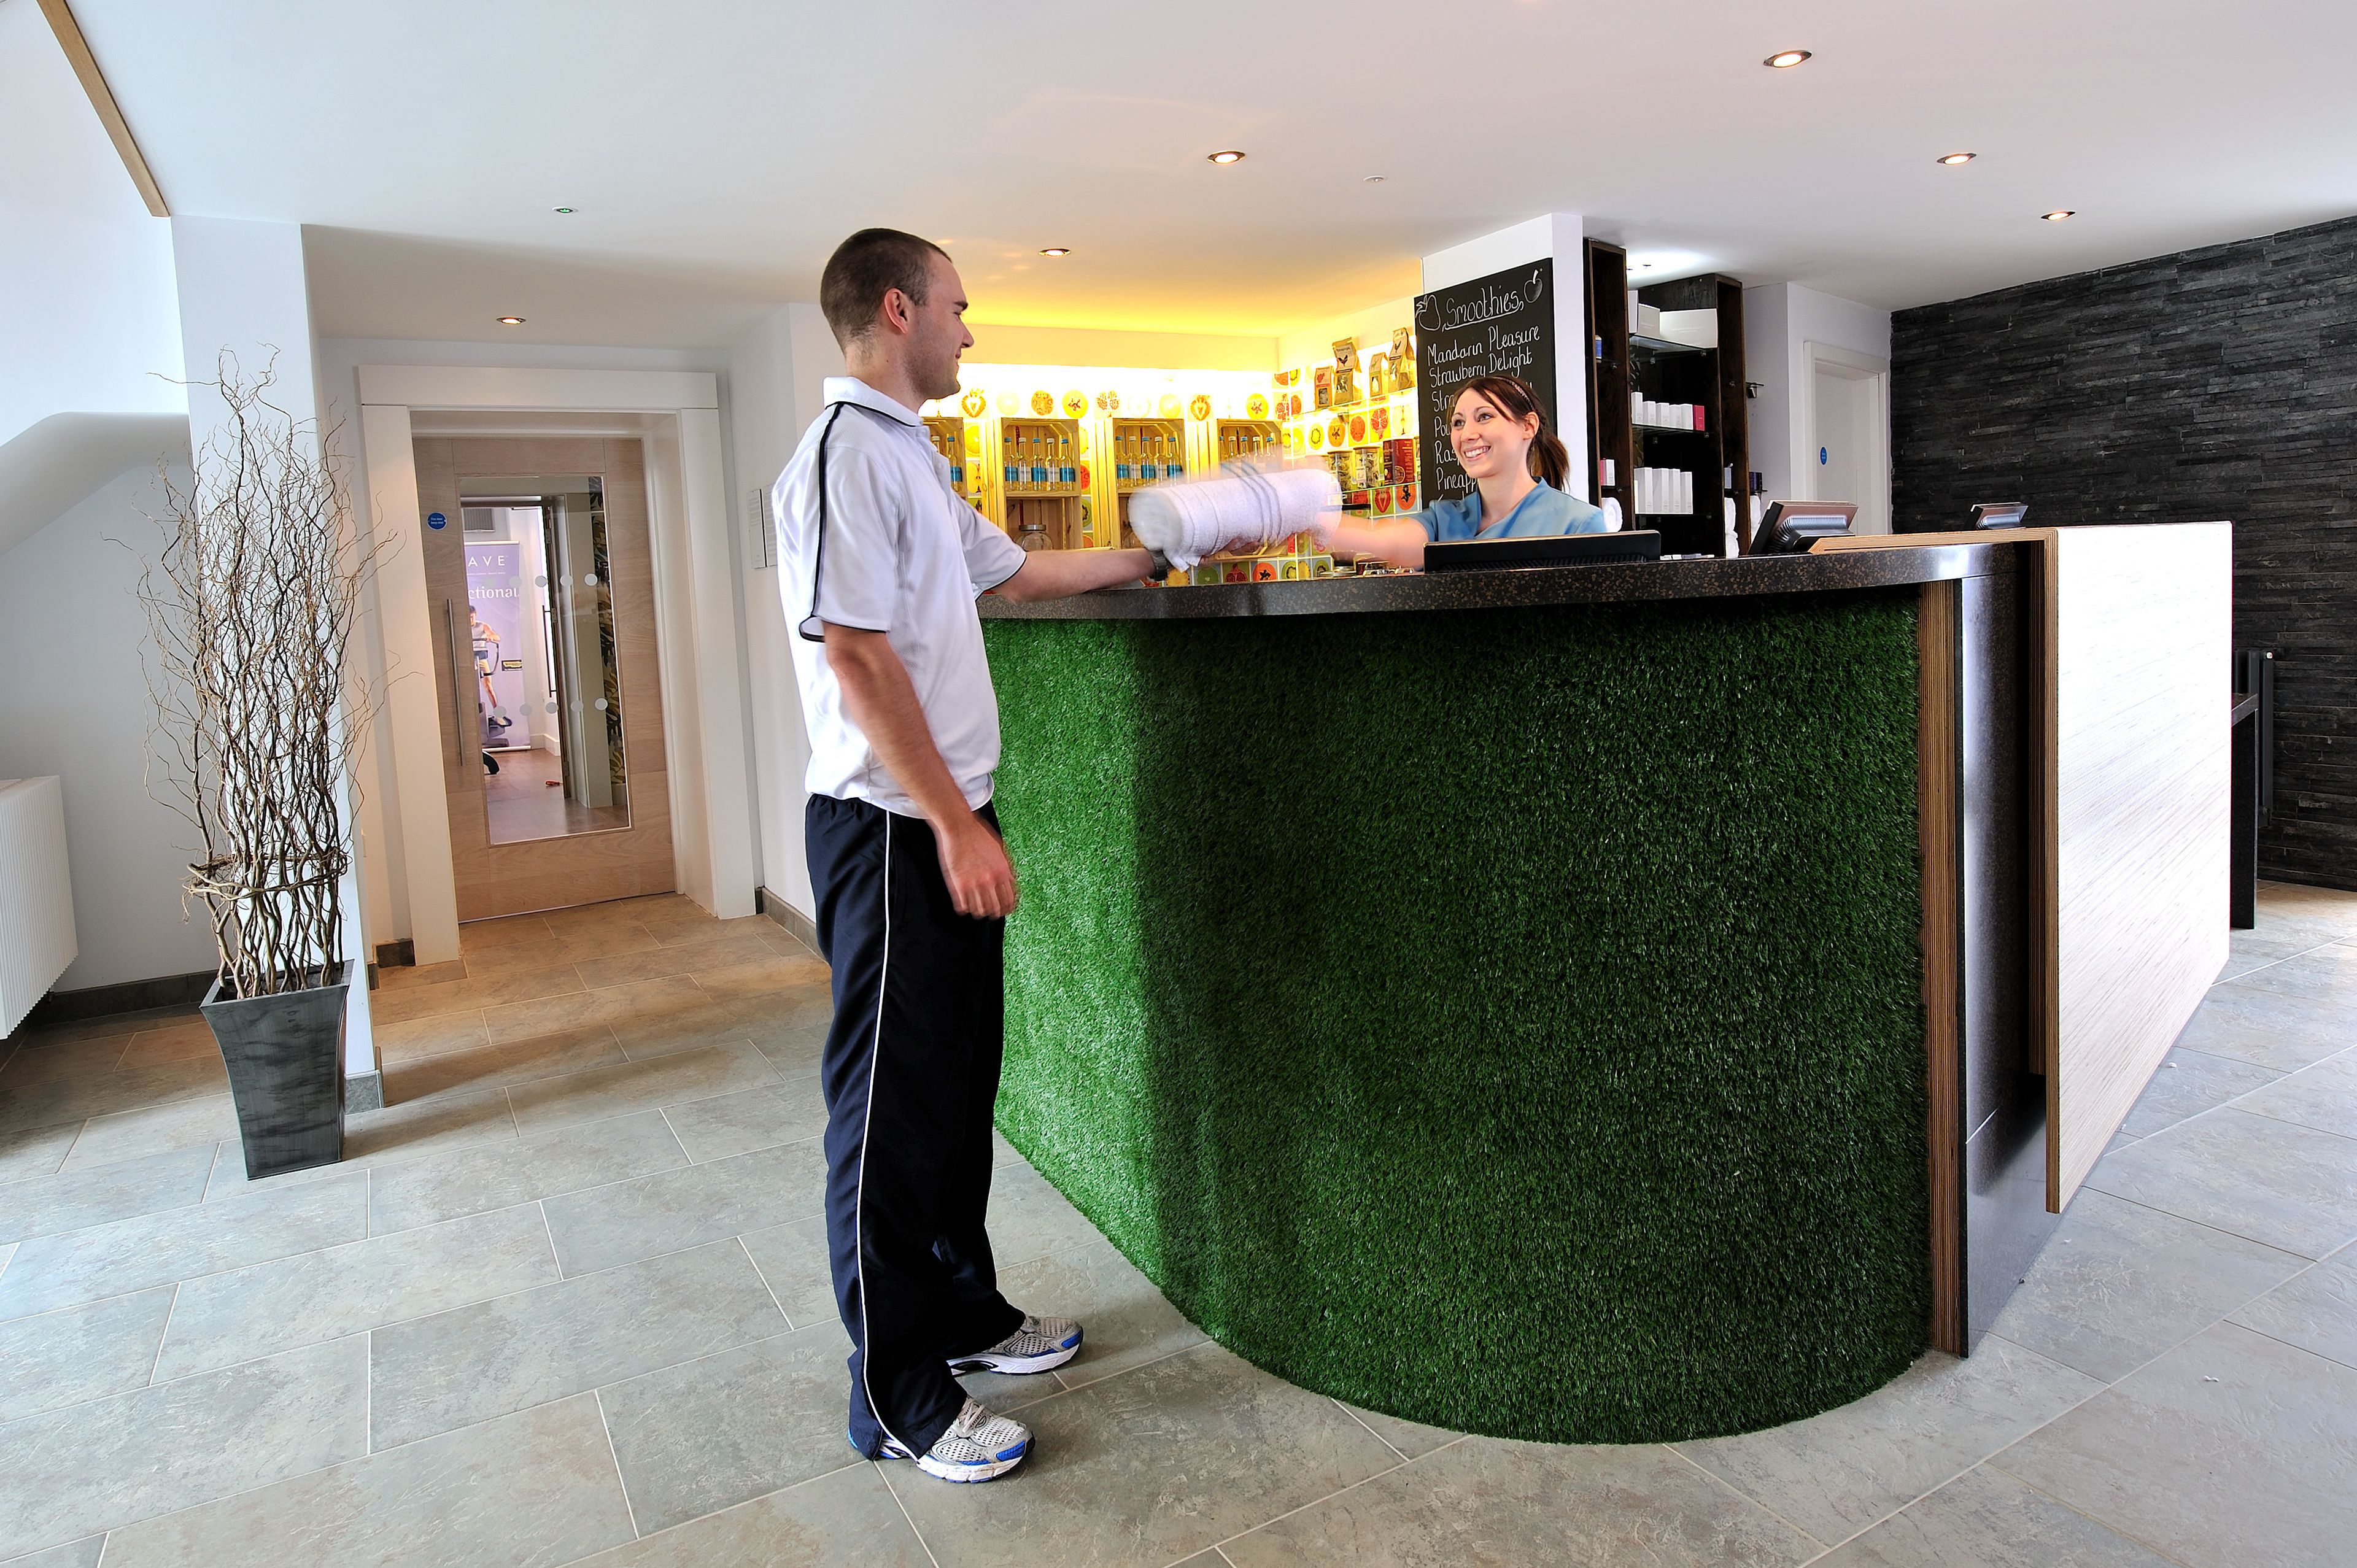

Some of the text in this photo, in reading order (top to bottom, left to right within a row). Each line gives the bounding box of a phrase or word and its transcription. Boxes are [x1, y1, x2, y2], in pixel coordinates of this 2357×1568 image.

[1446, 285, 1519, 326] Smoothies
[1428, 325, 1540, 366] Mandarin Pleasure
[1429, 346, 1533, 388] Strawberry Delight
[468, 555, 505, 567] AVE
